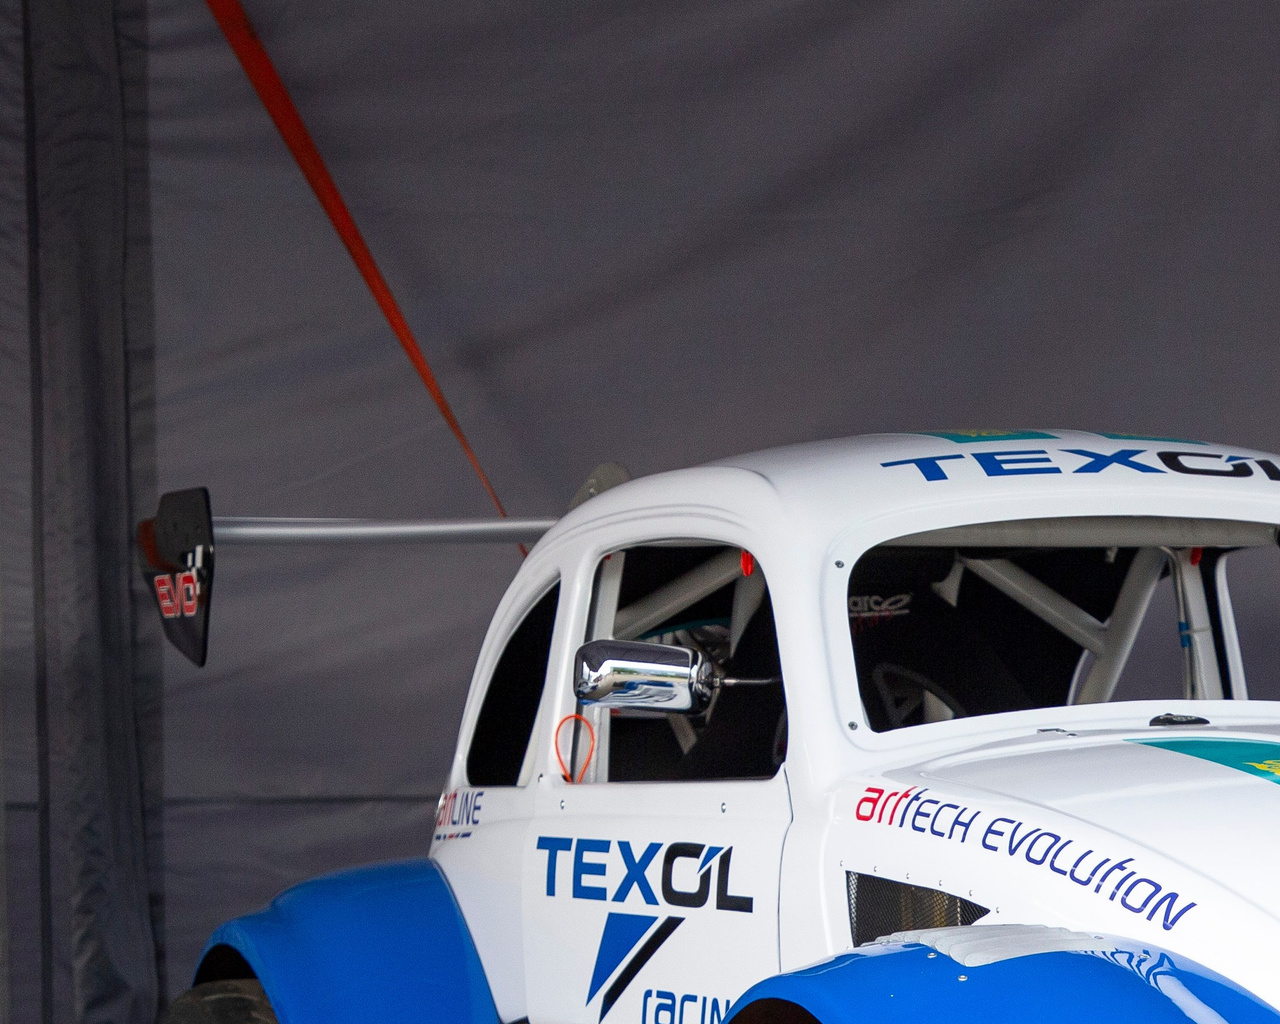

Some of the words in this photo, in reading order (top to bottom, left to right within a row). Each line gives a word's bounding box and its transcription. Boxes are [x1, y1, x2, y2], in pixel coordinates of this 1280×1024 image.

[154, 572, 198, 619] EVO
[848, 592, 914, 611] arco
[536, 836, 754, 914] TEXOL
